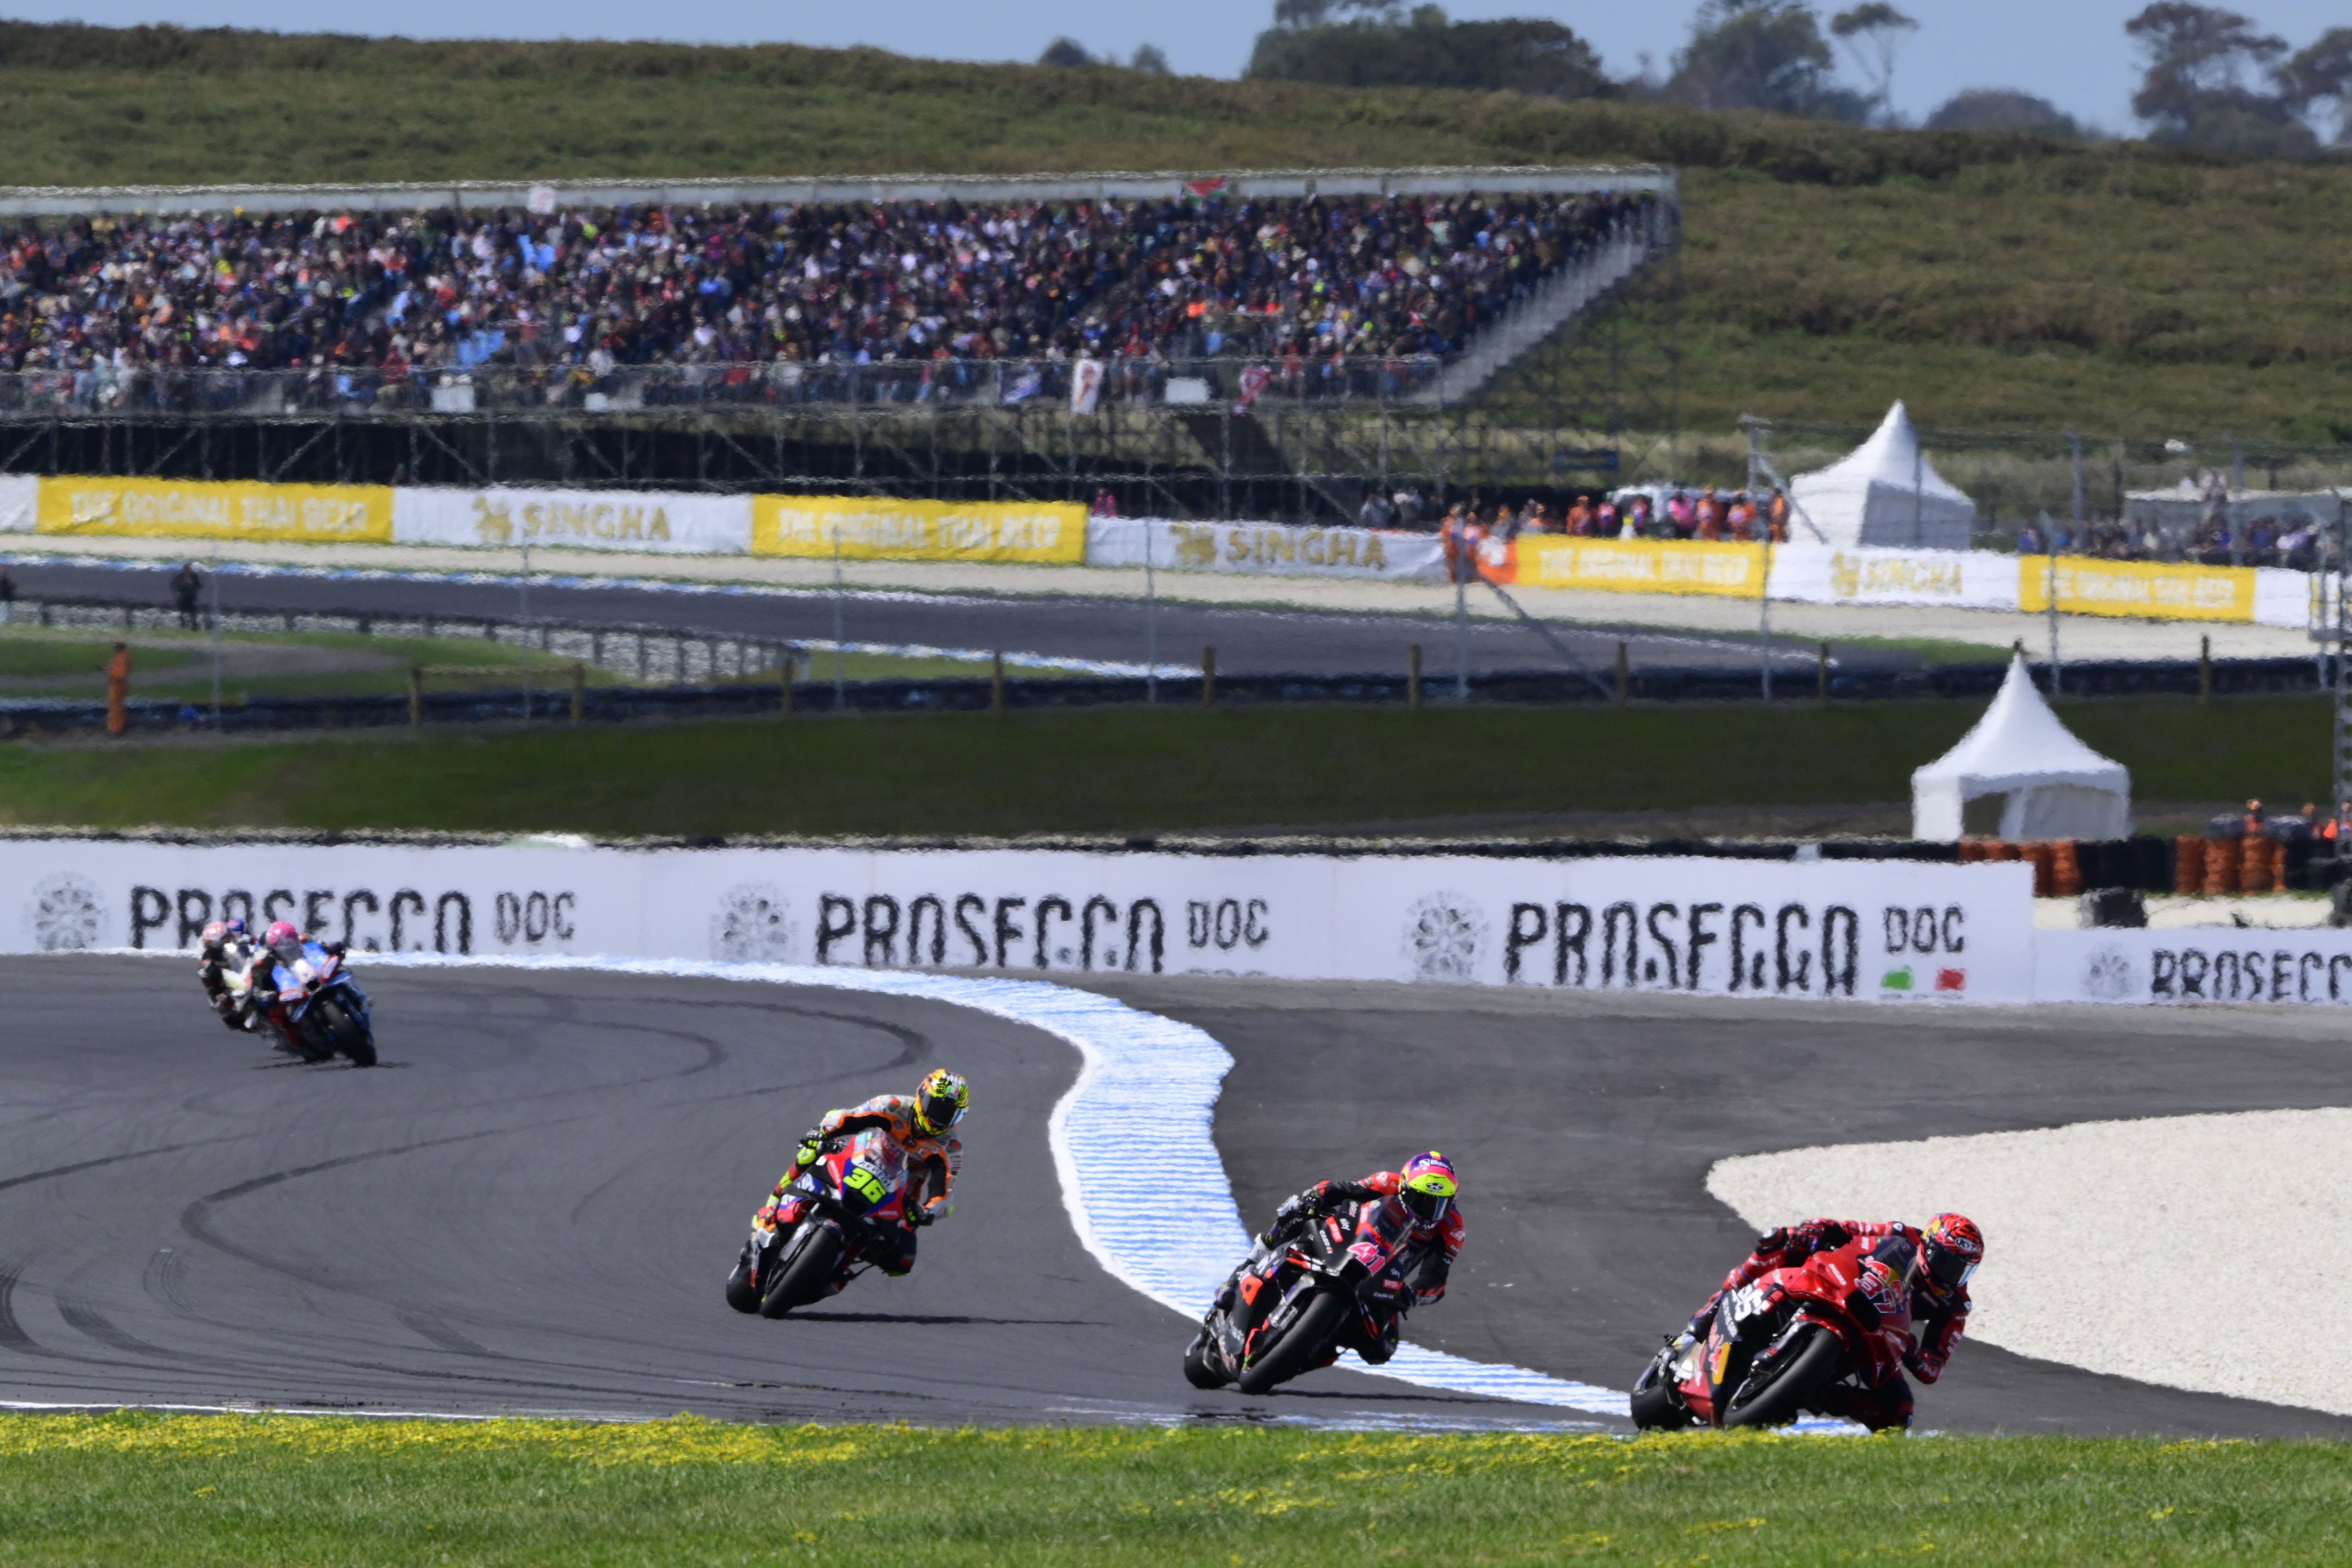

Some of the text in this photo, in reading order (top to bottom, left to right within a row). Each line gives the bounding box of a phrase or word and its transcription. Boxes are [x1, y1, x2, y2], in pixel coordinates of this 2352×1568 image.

[523, 503, 670, 541] SINGHA
[1226, 529, 1388, 571] SINGHA
[495, 890, 575, 945] DOC
[815, 892, 1270, 974] PROSECCO DOC
[1503, 900, 1965, 996] PROSECCO DOC
[843, 1167, 886, 1204] 36
[1346, 1241, 1386, 1278] 41
